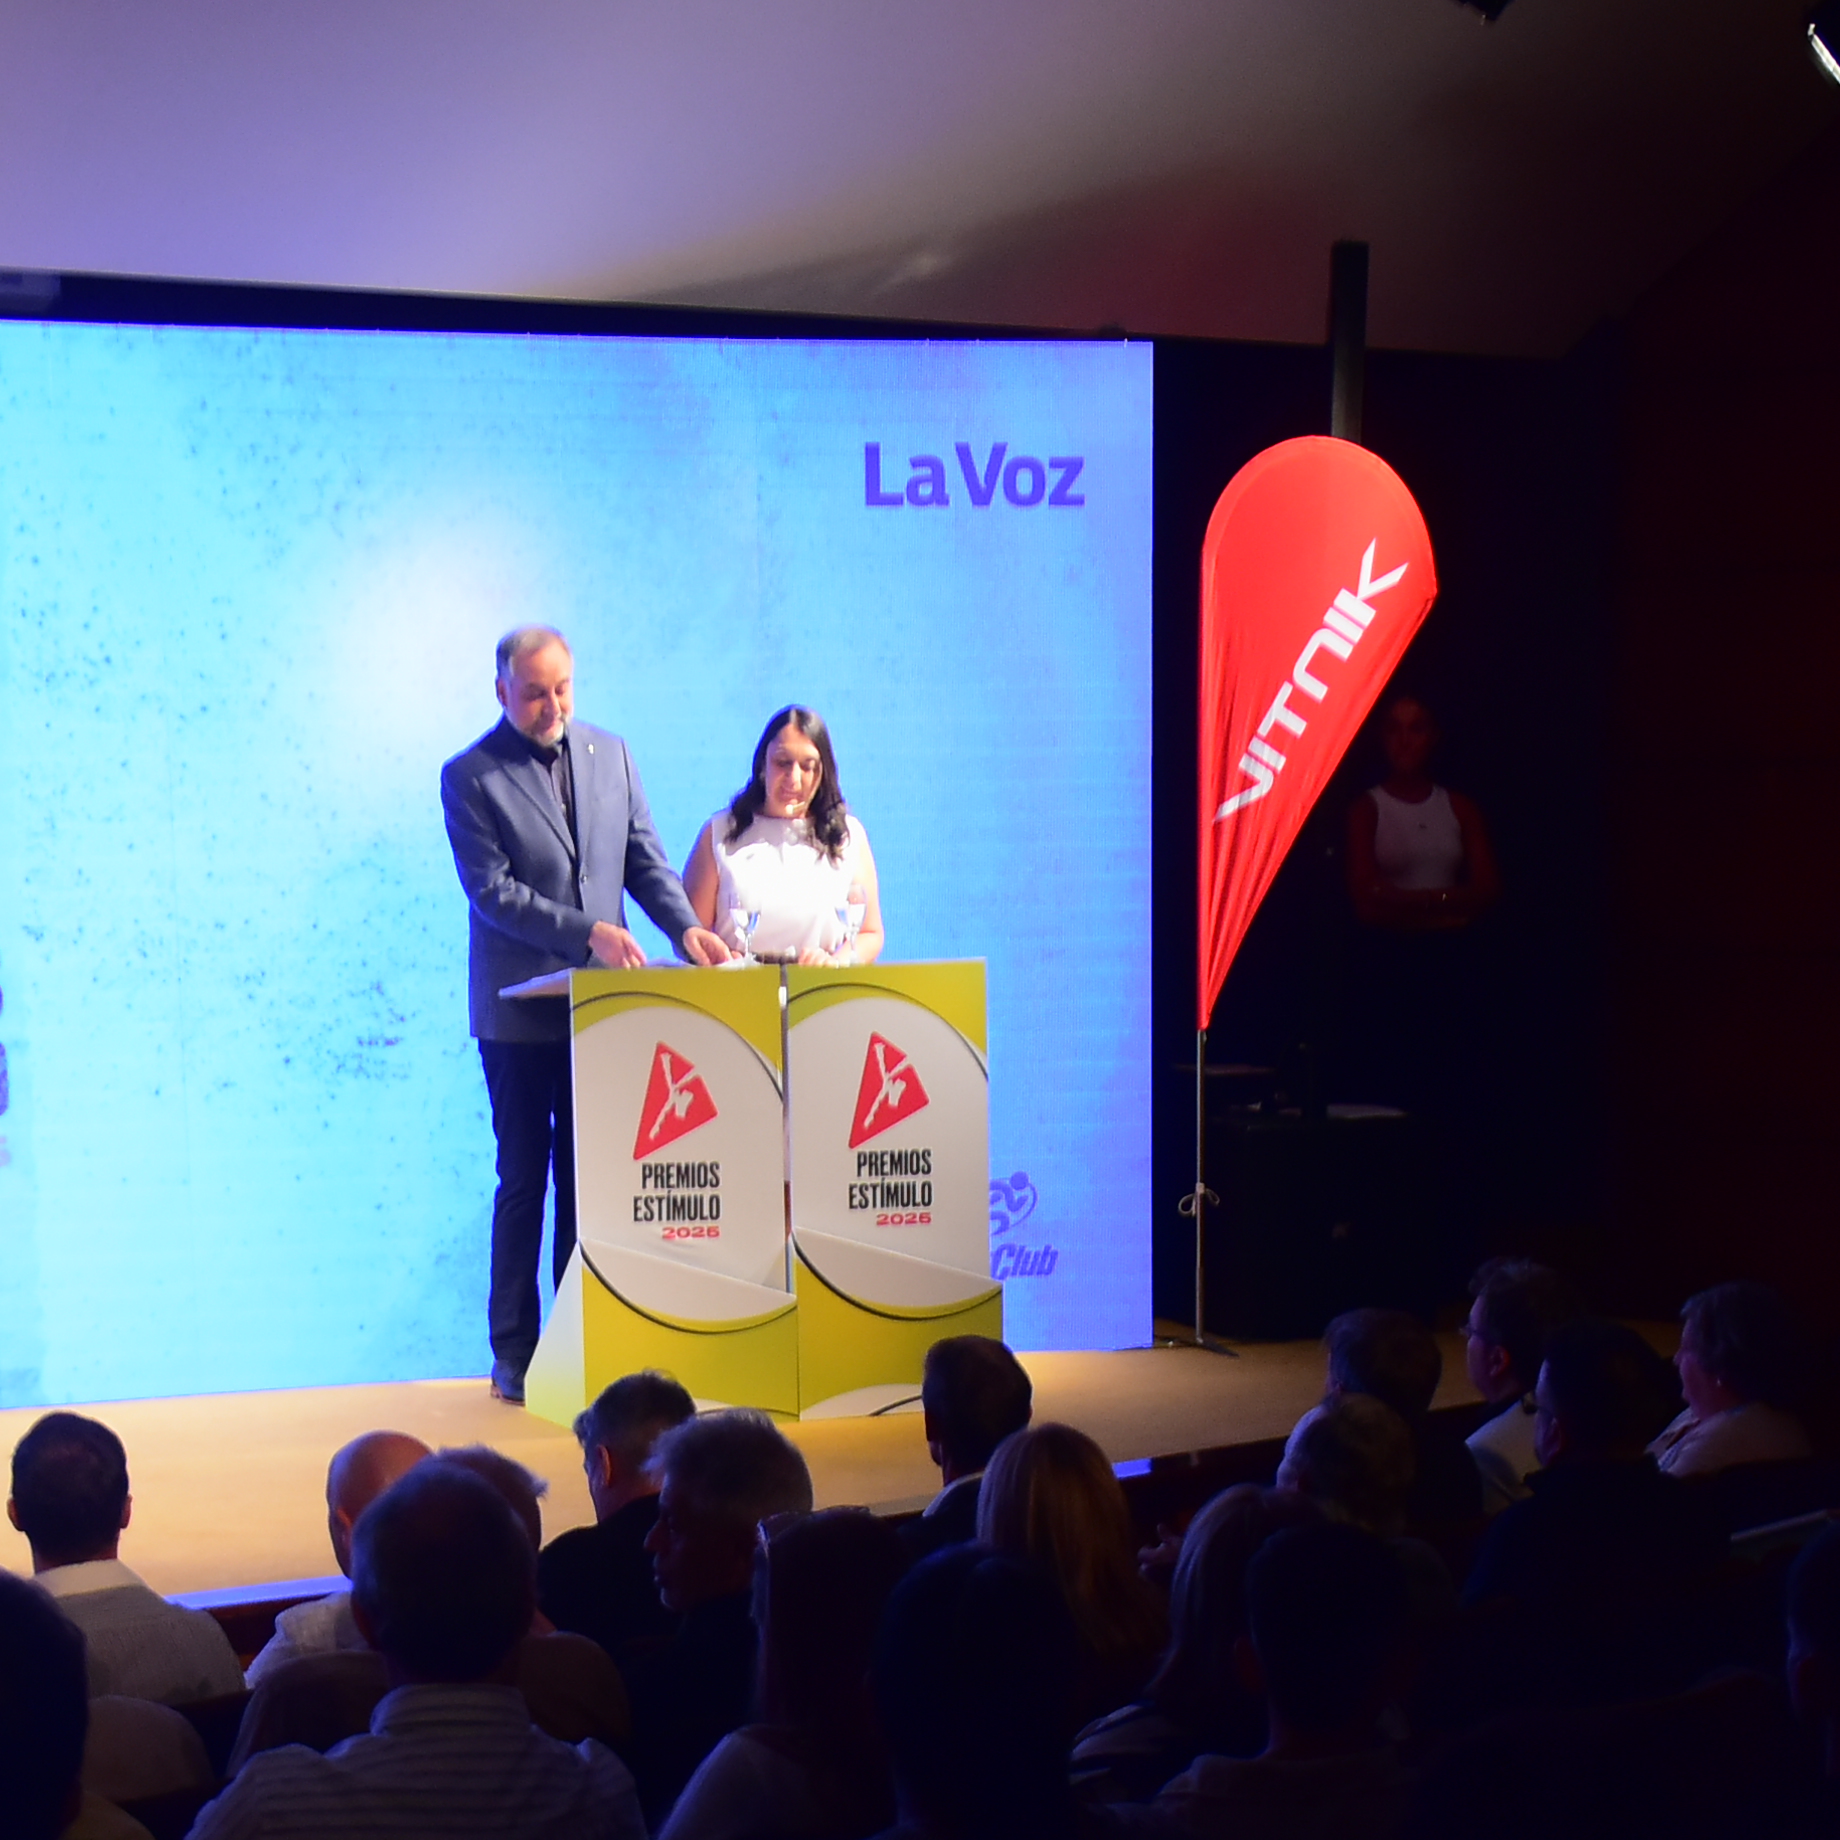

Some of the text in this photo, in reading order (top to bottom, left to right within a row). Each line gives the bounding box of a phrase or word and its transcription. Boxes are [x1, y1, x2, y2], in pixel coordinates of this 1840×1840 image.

[864, 441, 1086, 508] La Voz
[1212, 537, 1409, 824] VITNIK
[642, 1162, 720, 1189] PREMIOS
[856, 1149, 932, 1177] PREMIOS
[633, 1189, 721, 1222] ESTÍMULO
[848, 1176, 933, 1210] ESTÍMULO
[661, 1226, 720, 1239] 2025
[876, 1212, 932, 1226] 2025
